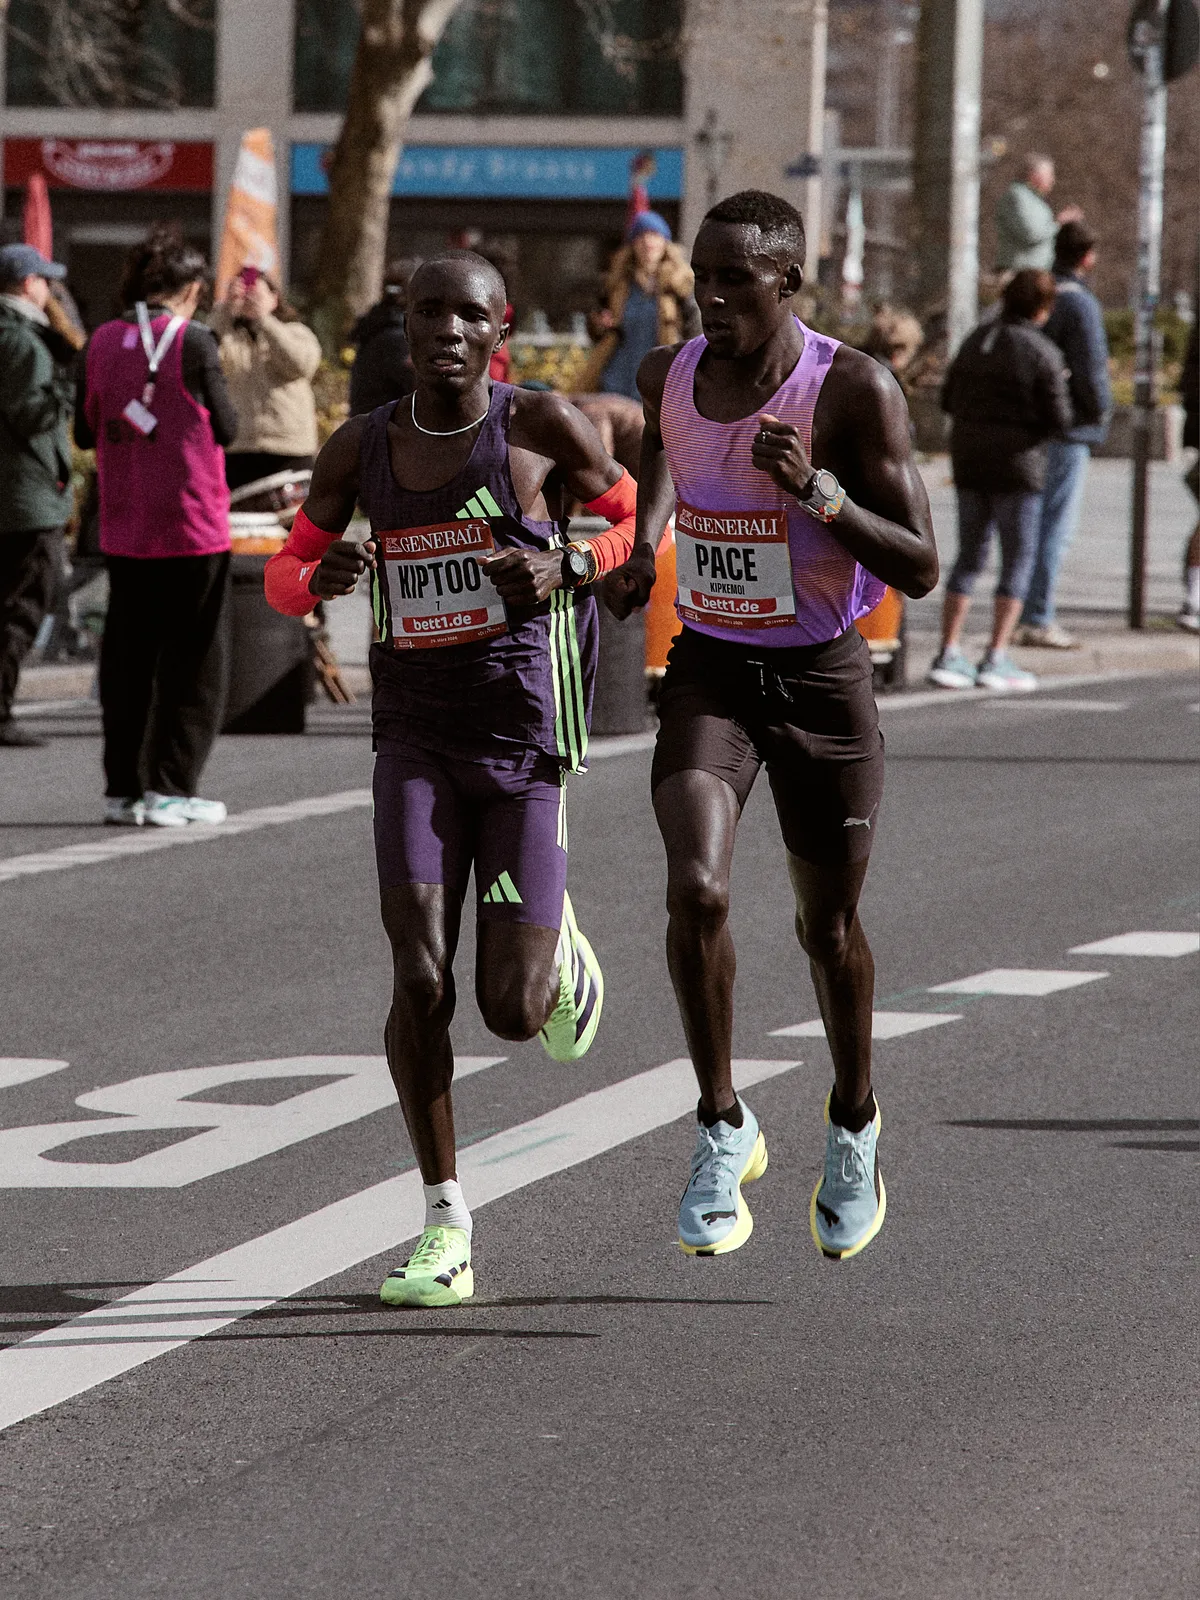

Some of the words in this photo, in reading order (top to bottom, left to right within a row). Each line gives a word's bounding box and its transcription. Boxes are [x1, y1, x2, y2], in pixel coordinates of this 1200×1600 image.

[693, 515, 778, 536] GENERALI
[400, 526, 484, 553] GENERALI
[694, 543, 758, 582] PACE
[398, 557, 482, 599] KIPTOO
[709, 582, 746, 596] KIPKEMOI
[701, 595, 760, 613] bett1.de
[412, 613, 472, 631] bett1.de
